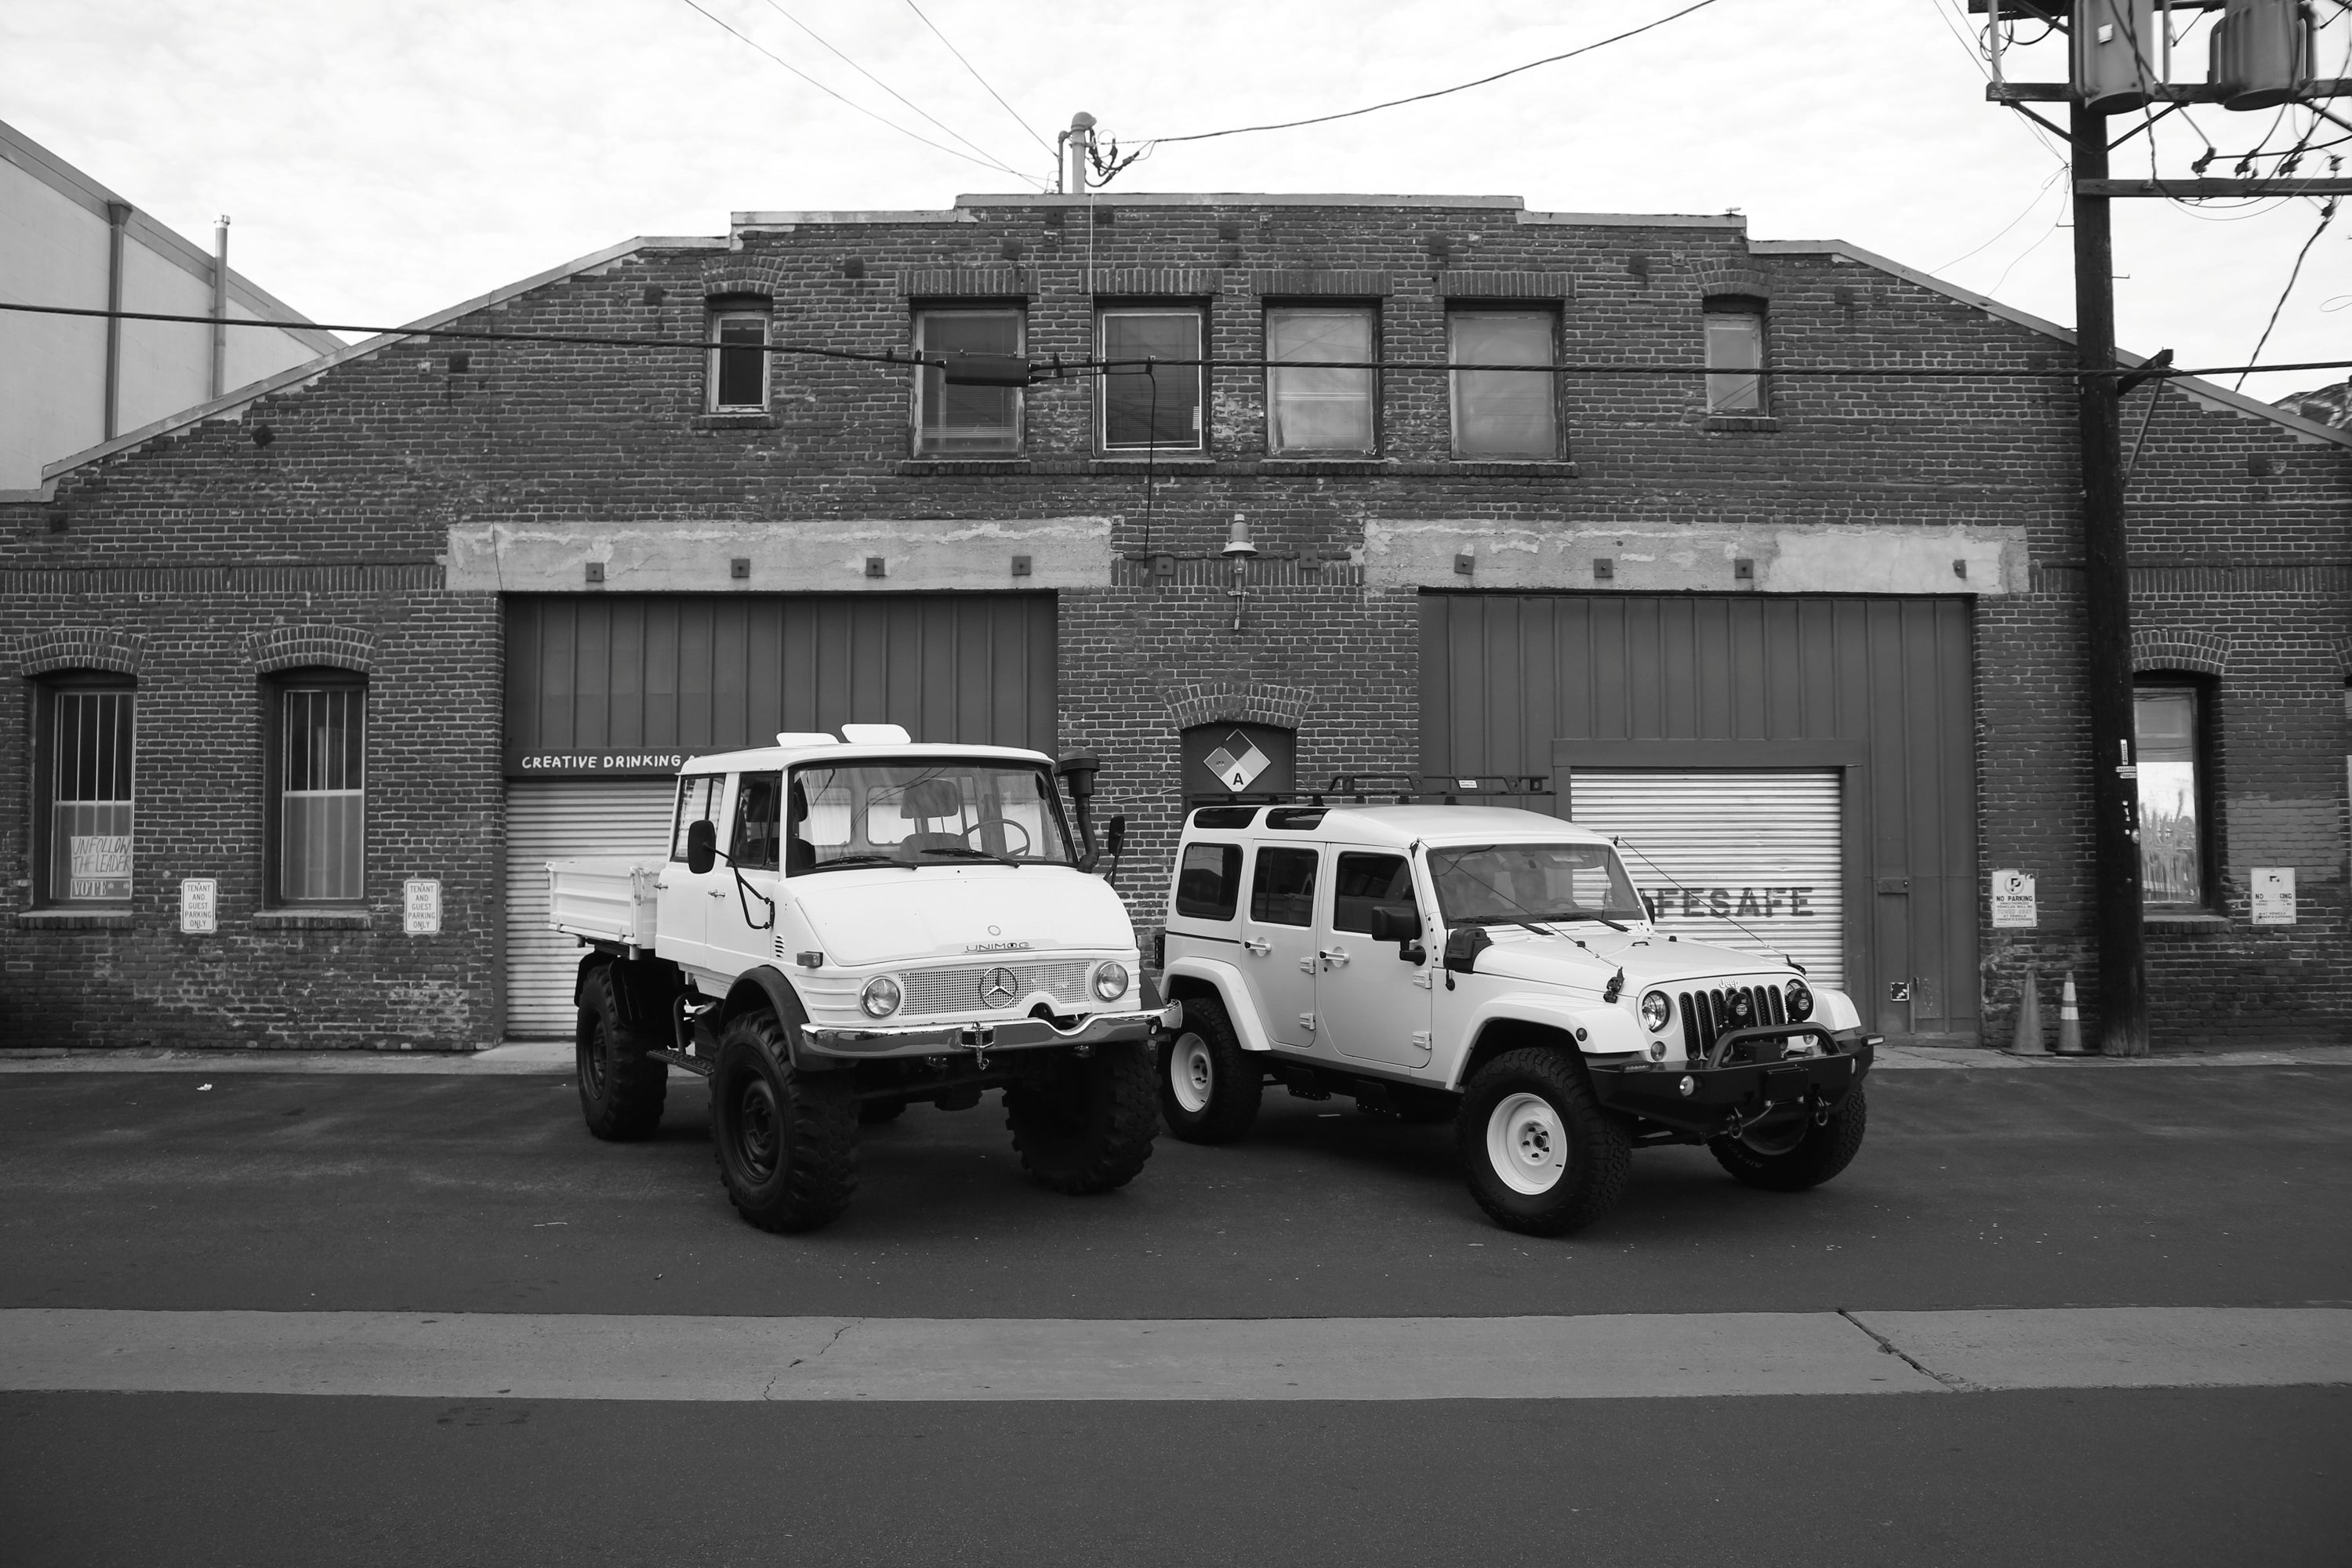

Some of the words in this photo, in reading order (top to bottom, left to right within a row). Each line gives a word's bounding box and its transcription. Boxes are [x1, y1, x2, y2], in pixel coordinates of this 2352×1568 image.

[521, 755, 597, 769] CREATIVE
[603, 754, 681, 768] DRINKING
[1232, 772, 1244, 786] A
[72, 837, 132, 855] UNFOLLOW
[73, 855, 95, 874] THE
[95, 853, 132, 873] LEADER
[74, 880, 107, 896] VOTE
[966, 942, 1029, 952] UNIMOG
[1719, 978, 1740, 989] Jeep
